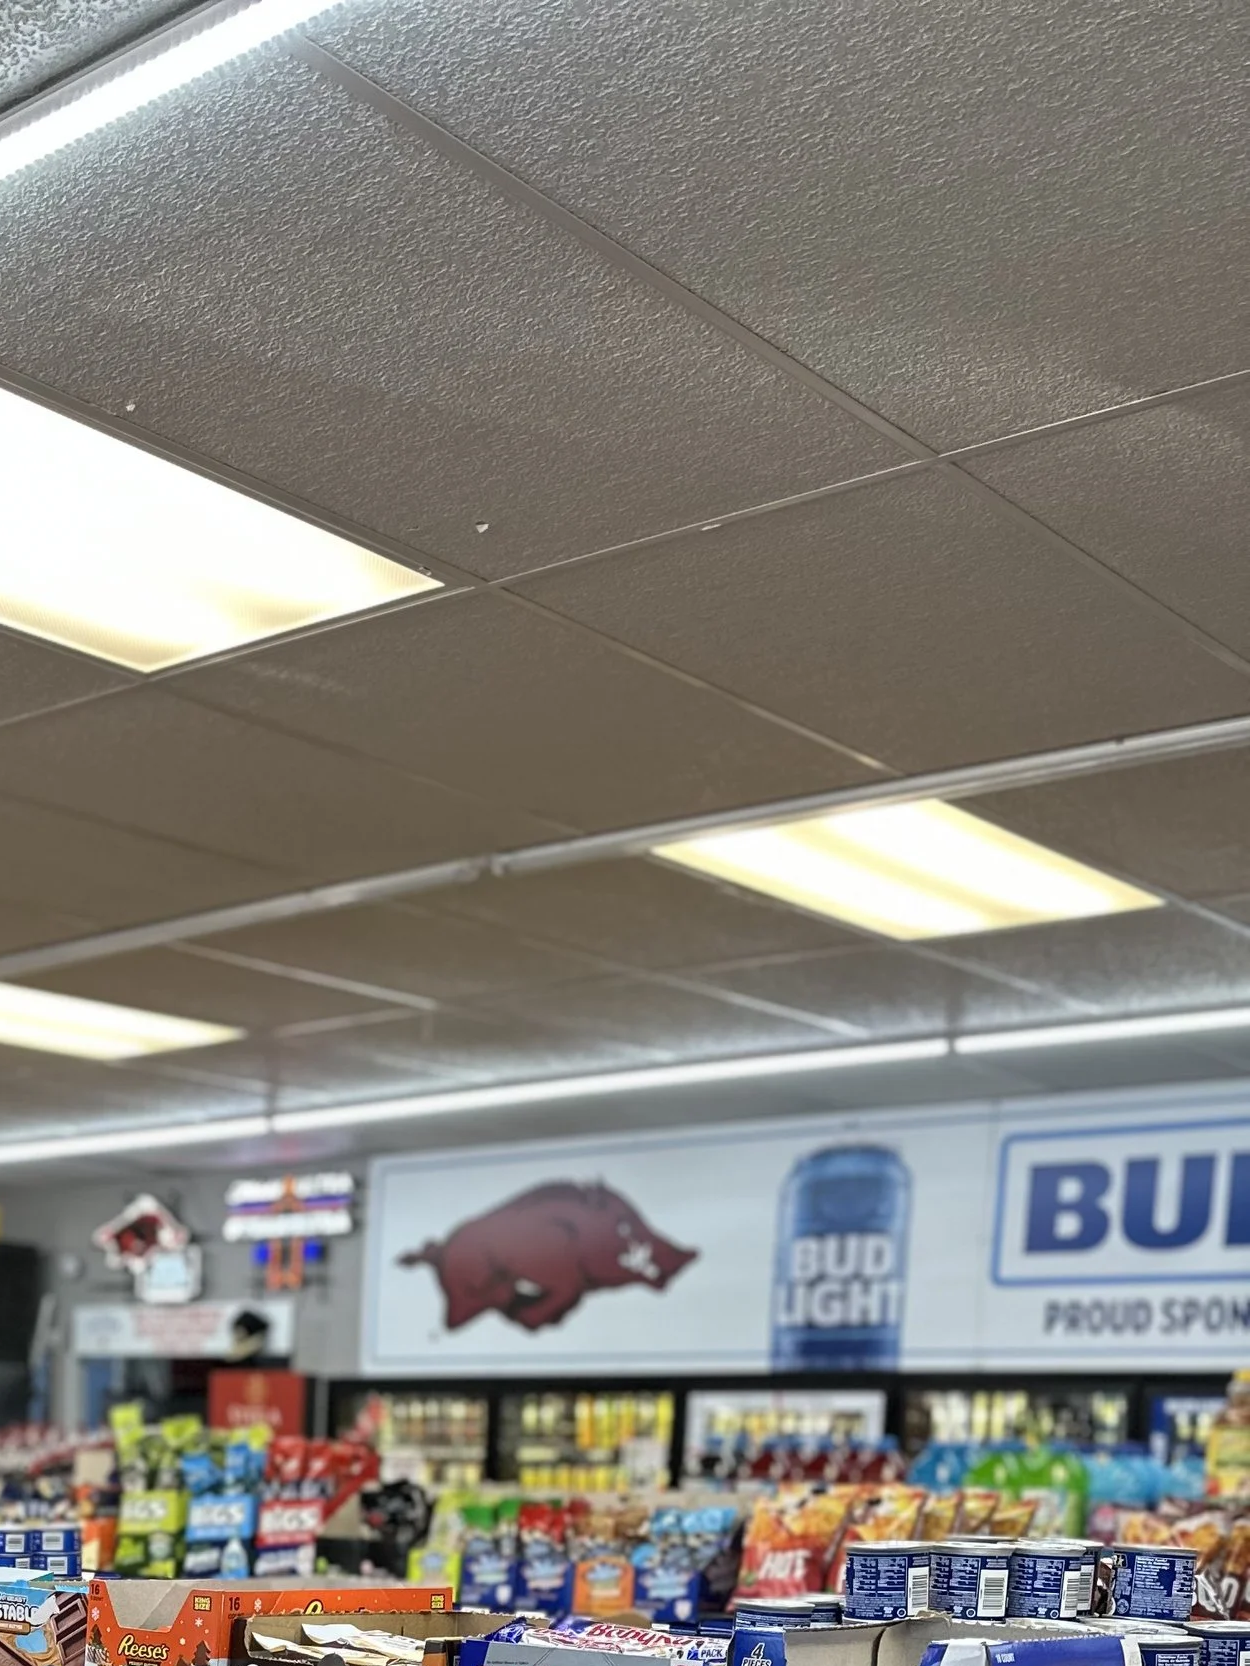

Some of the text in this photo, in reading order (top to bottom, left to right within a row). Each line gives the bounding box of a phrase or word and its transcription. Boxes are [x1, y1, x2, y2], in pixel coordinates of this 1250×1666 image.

[1023, 1151, 1250, 1255] BU
[792, 1233, 894, 1278] BUD
[779, 1278, 900, 1326] LIGHT
[1043, 1299, 1152, 1334] PROUD
[90, 1583, 100, 1595] 16
[229, 1597, 240, 1611] 16
[752, 1643, 765, 1659] 4
